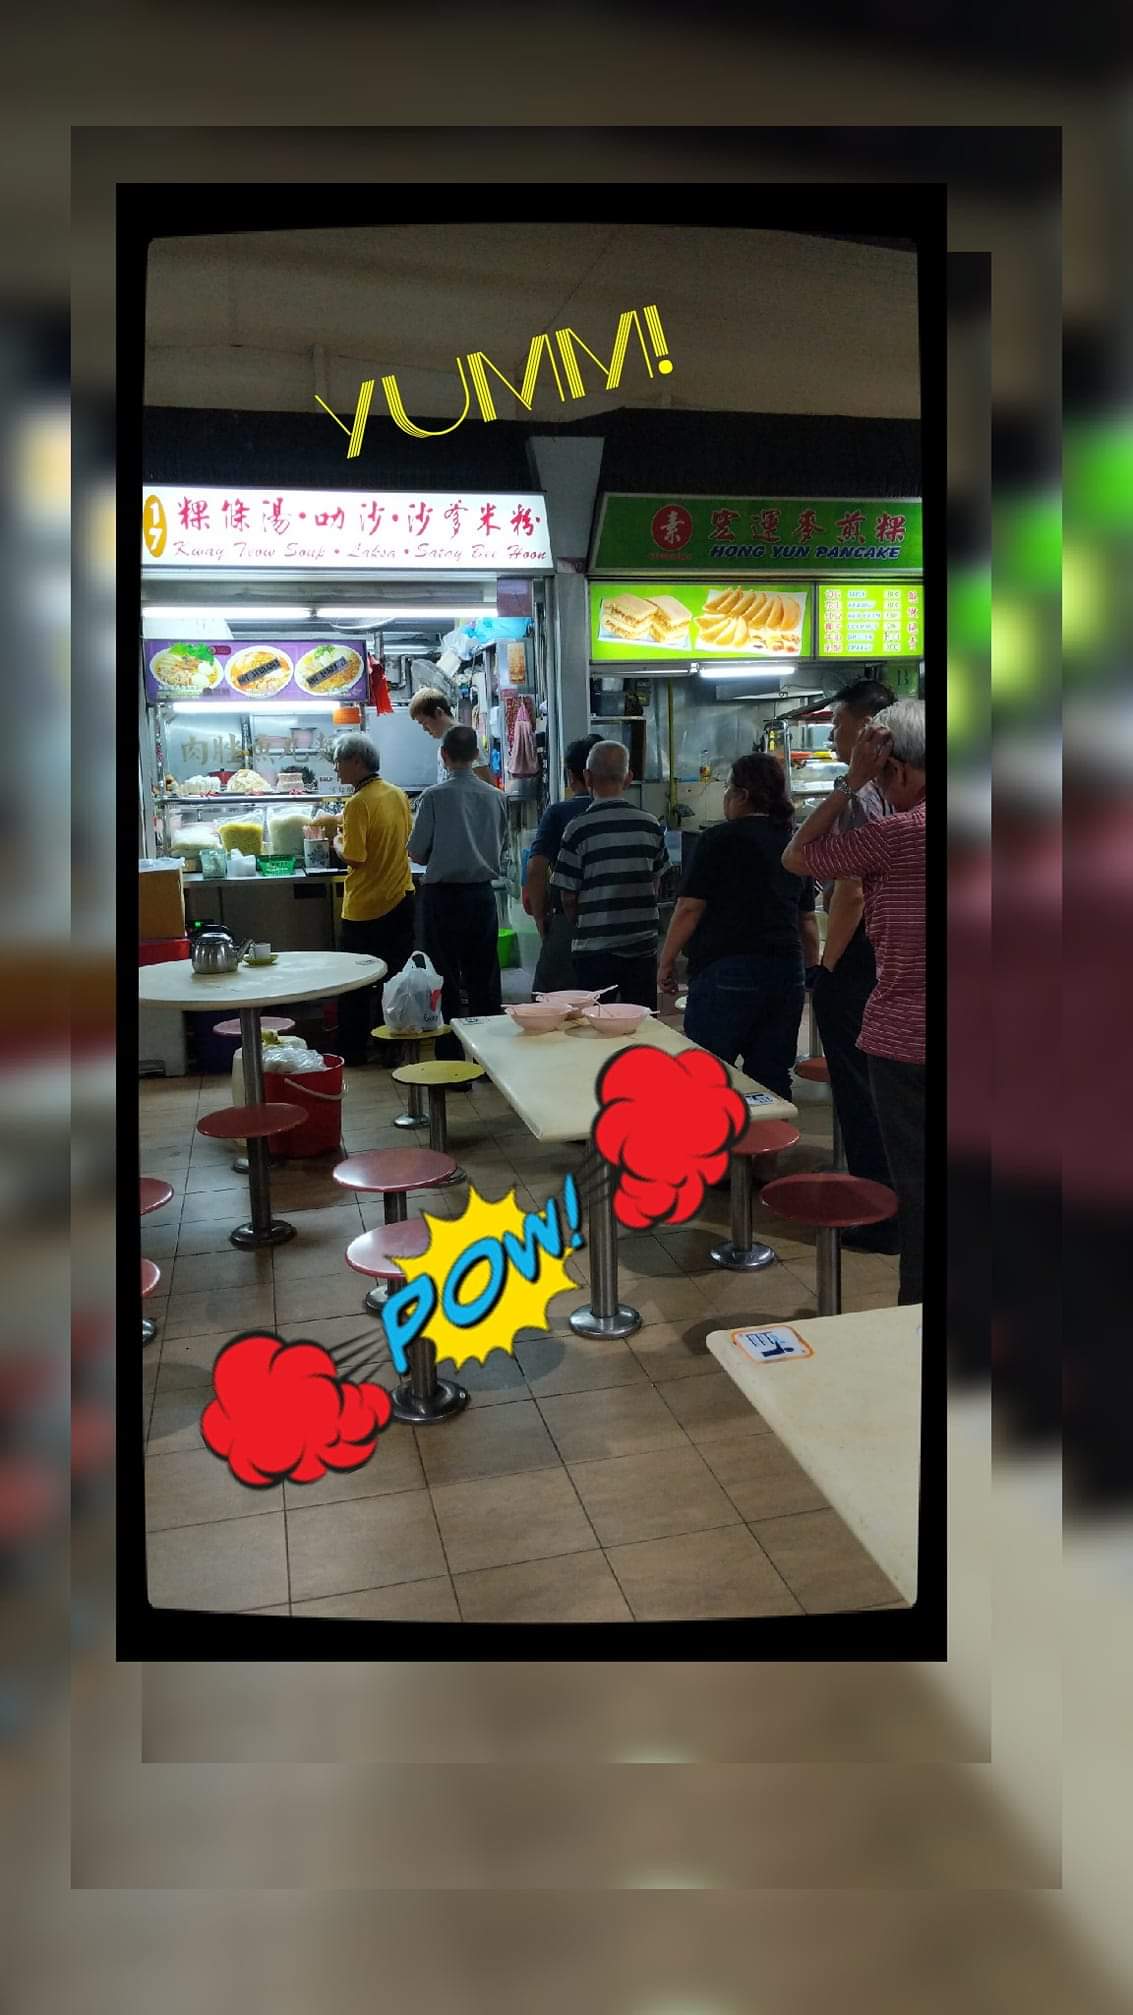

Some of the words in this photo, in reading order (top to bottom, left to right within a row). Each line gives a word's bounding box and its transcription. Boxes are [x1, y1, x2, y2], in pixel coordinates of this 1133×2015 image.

[659, 510, 685, 545] 素
[284, 542, 326, 560] Soup
[507, 544, 547, 560] Hoon
[709, 545, 765, 559] HONG
[771, 545, 810, 559] YUN
[815, 545, 902, 560] PANCAKE
